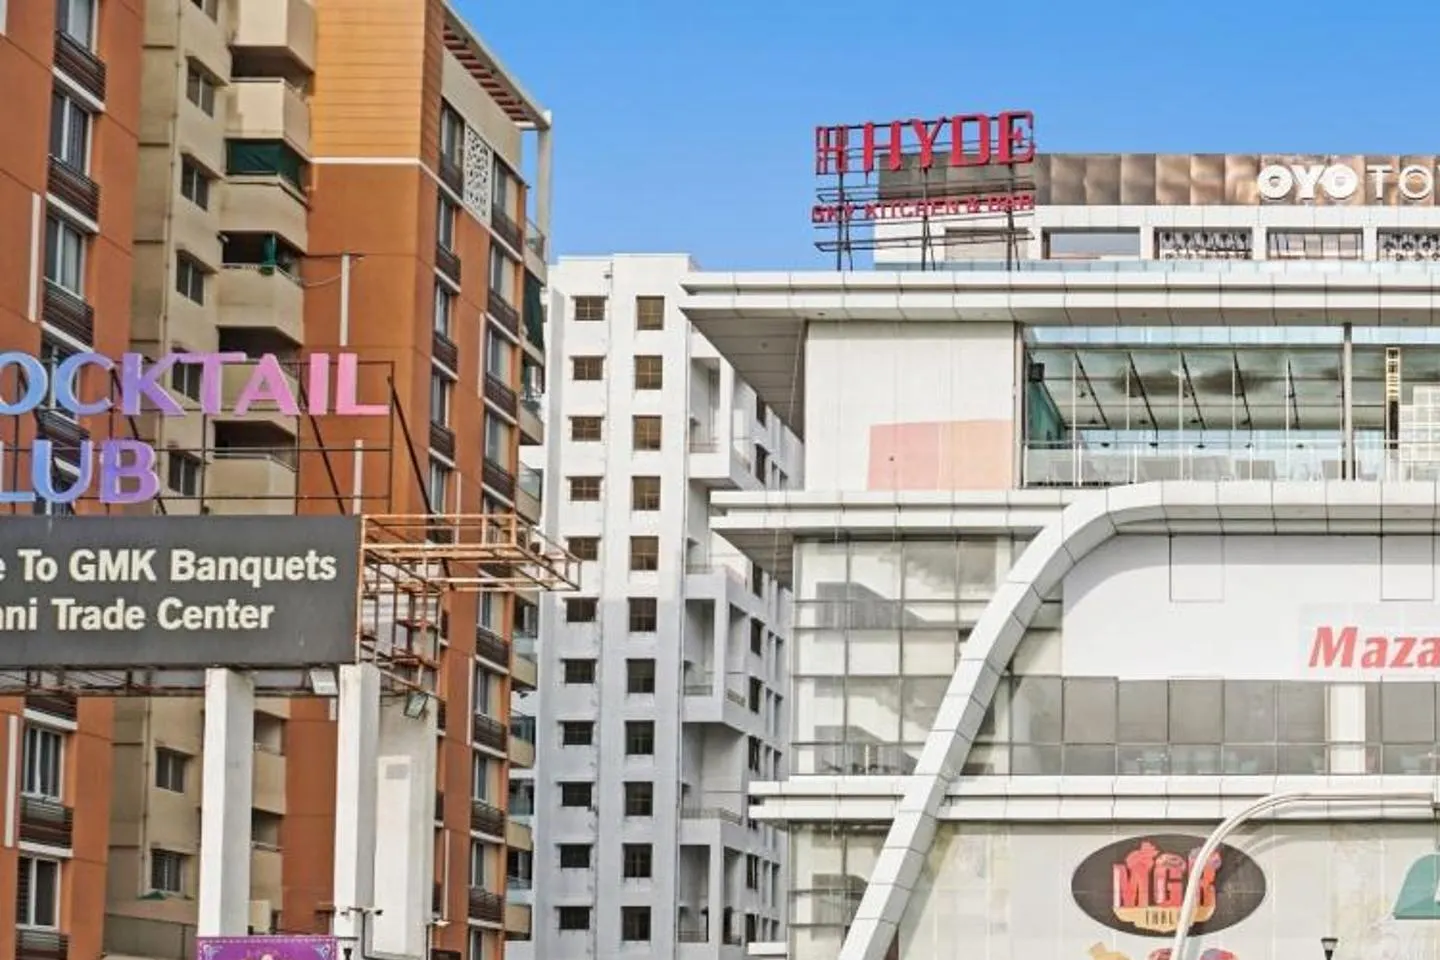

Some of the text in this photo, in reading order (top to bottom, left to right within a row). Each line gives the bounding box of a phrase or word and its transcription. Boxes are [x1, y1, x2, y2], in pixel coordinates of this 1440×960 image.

[1258, 163, 1358, 200] OYO
[18, 549, 58, 582] To
[69, 549, 156, 582] GMK
[170, 549, 337, 588] Banquets
[0, 597, 274, 631] ni Trade Center
